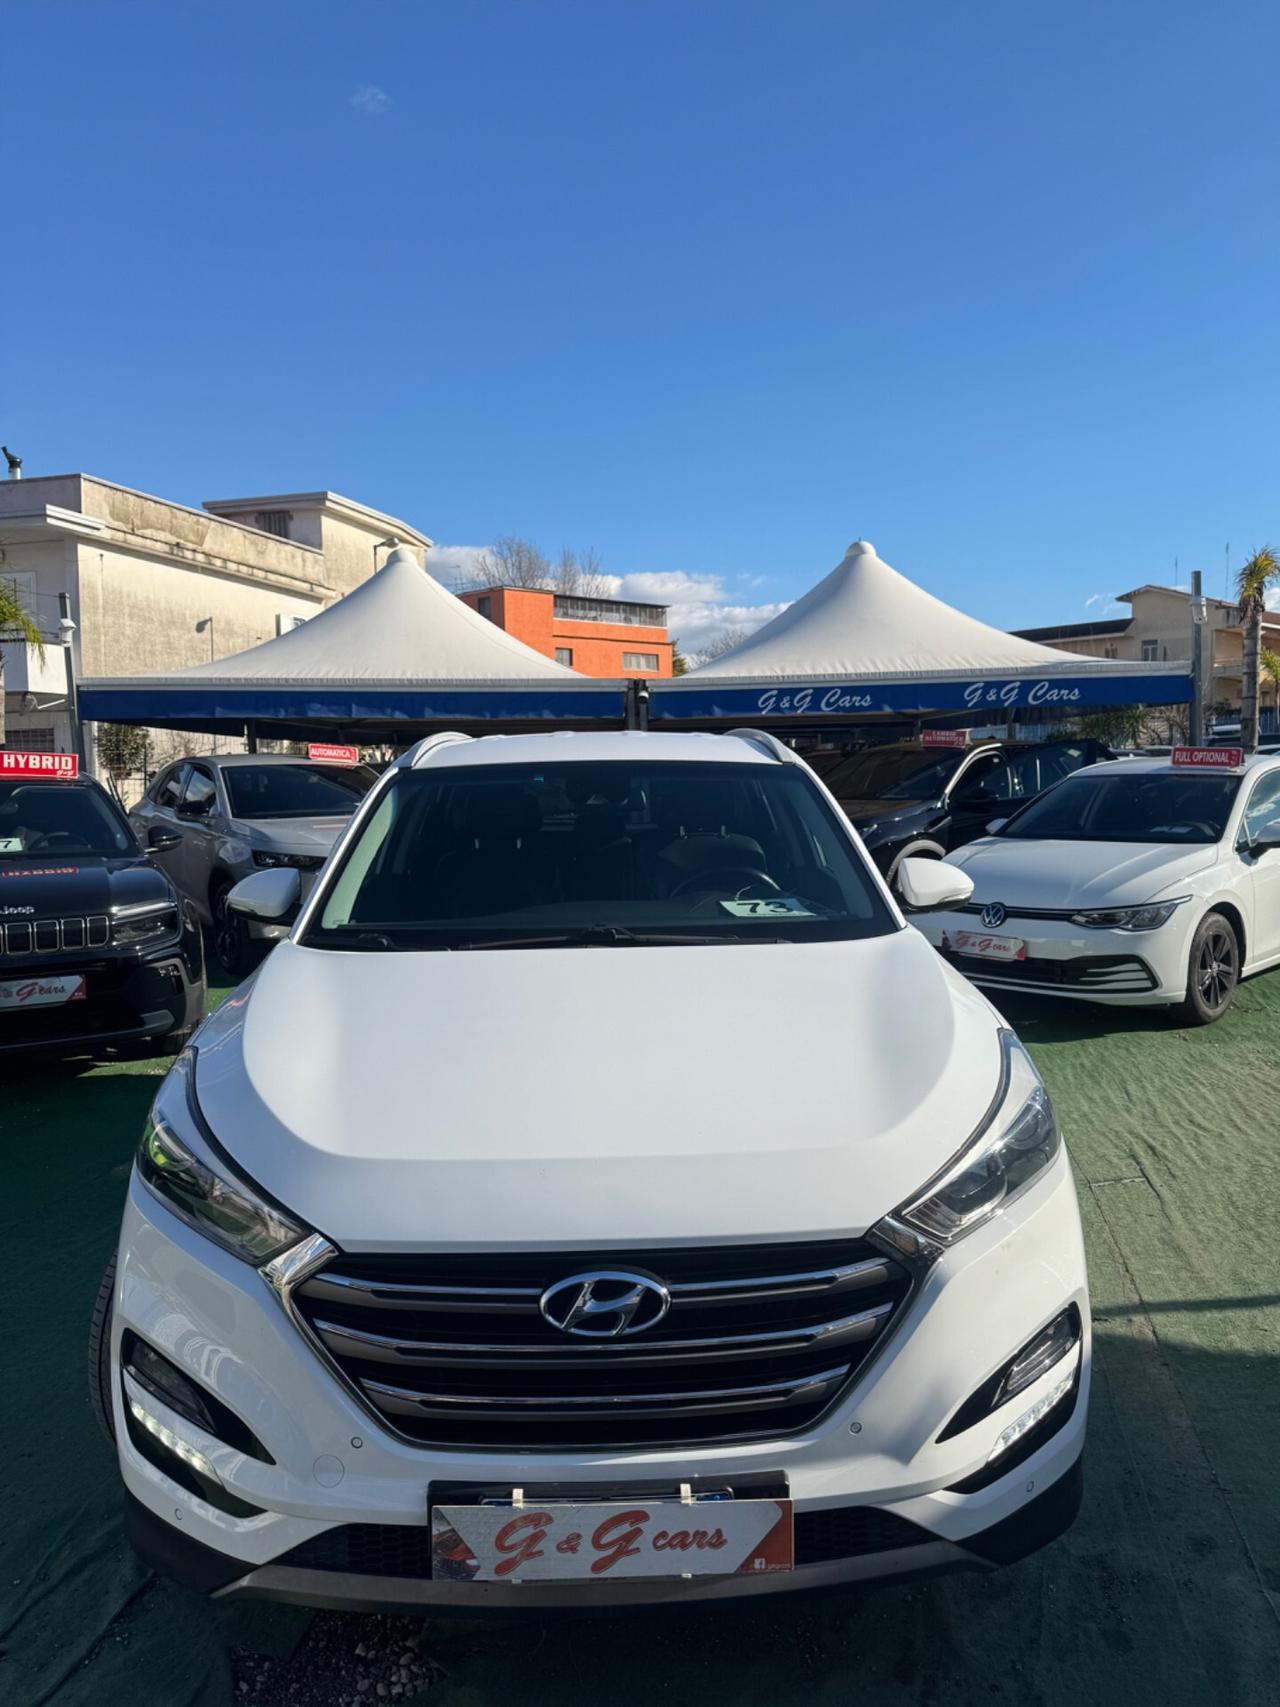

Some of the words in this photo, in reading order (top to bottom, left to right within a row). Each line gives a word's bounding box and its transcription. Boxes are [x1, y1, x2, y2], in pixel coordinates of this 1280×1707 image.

[820, 688, 872, 711] Cars
[1027, 681, 1080, 705] Cars
[3, 754, 73, 770] HYBRID
[1174, 751, 1191, 762] FULL
[1192, 751, 1230, 763] OPTIONAL
[736, 901, 794, 914] 73
[652, 1527, 727, 1551] cars
